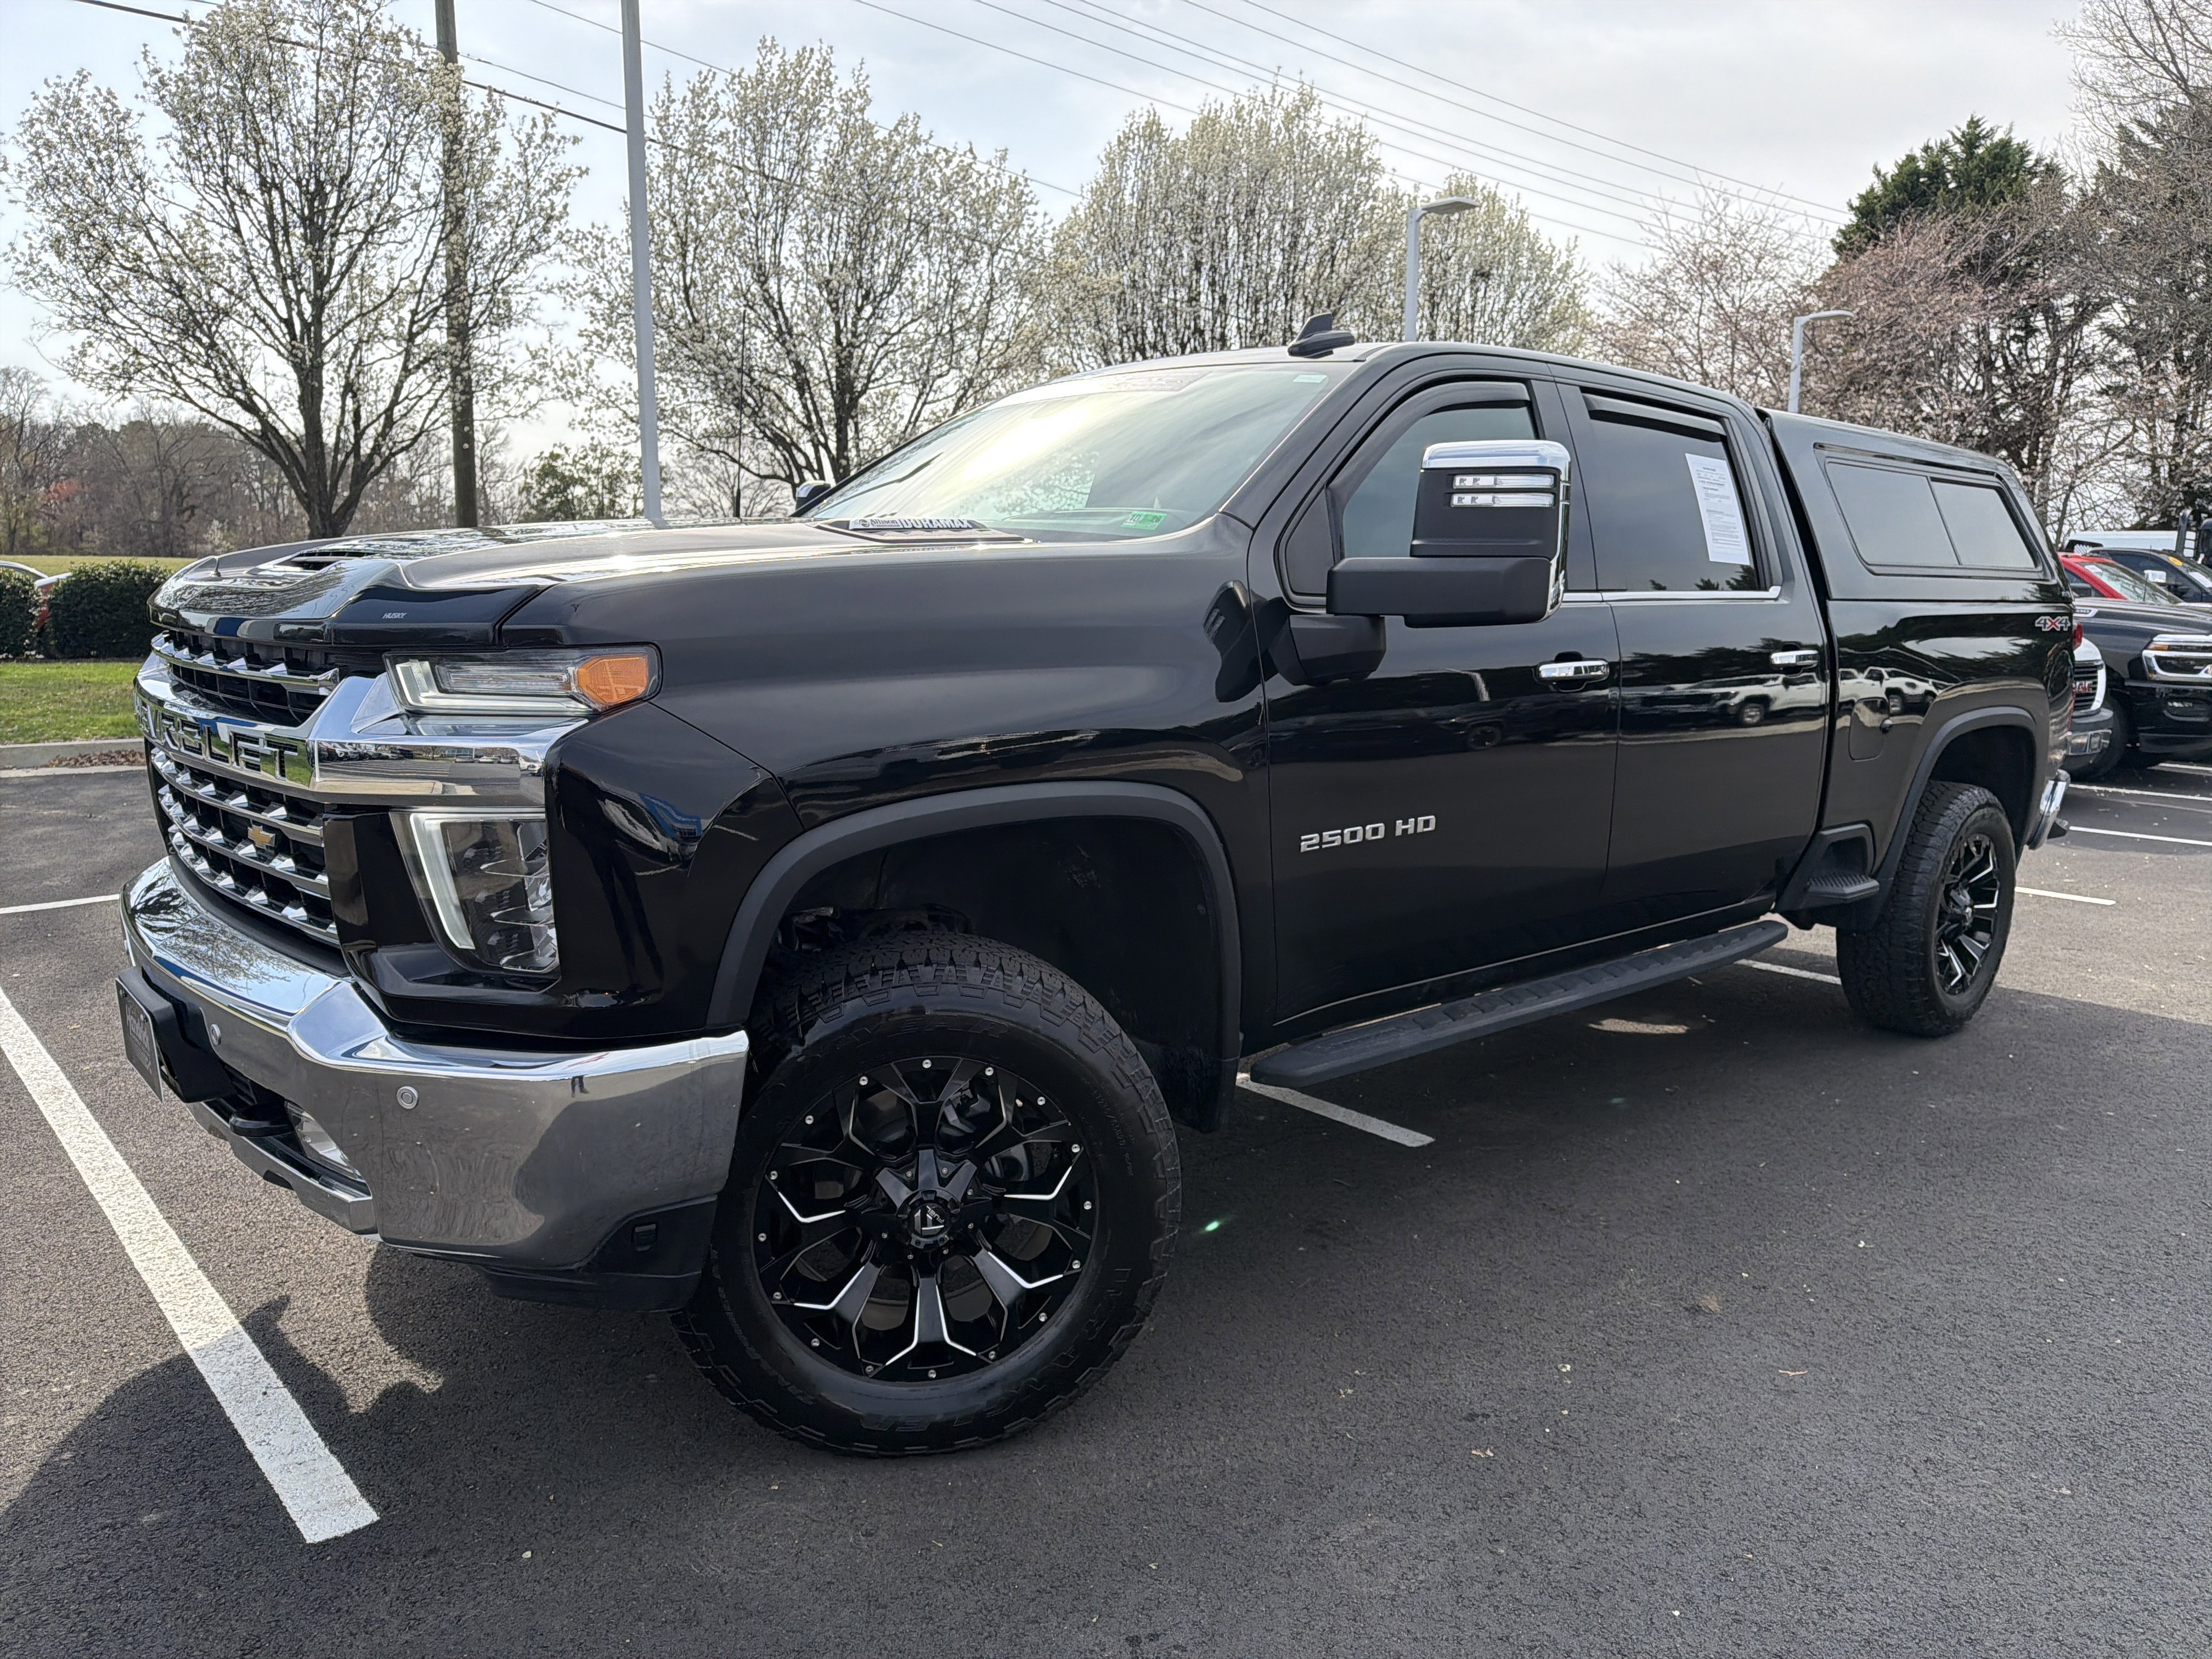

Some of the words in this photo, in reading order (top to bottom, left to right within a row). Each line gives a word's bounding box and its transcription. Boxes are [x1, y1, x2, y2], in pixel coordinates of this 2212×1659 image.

[870, 518, 899, 527] Allison
[902, 518, 973, 529] DURAMAX
[1130, 514, 1141, 522] 10
[1300, 822, 1385, 853] 2500
[1395, 815, 1436, 837] HD
[926, 1205, 945, 1224] FUEL
